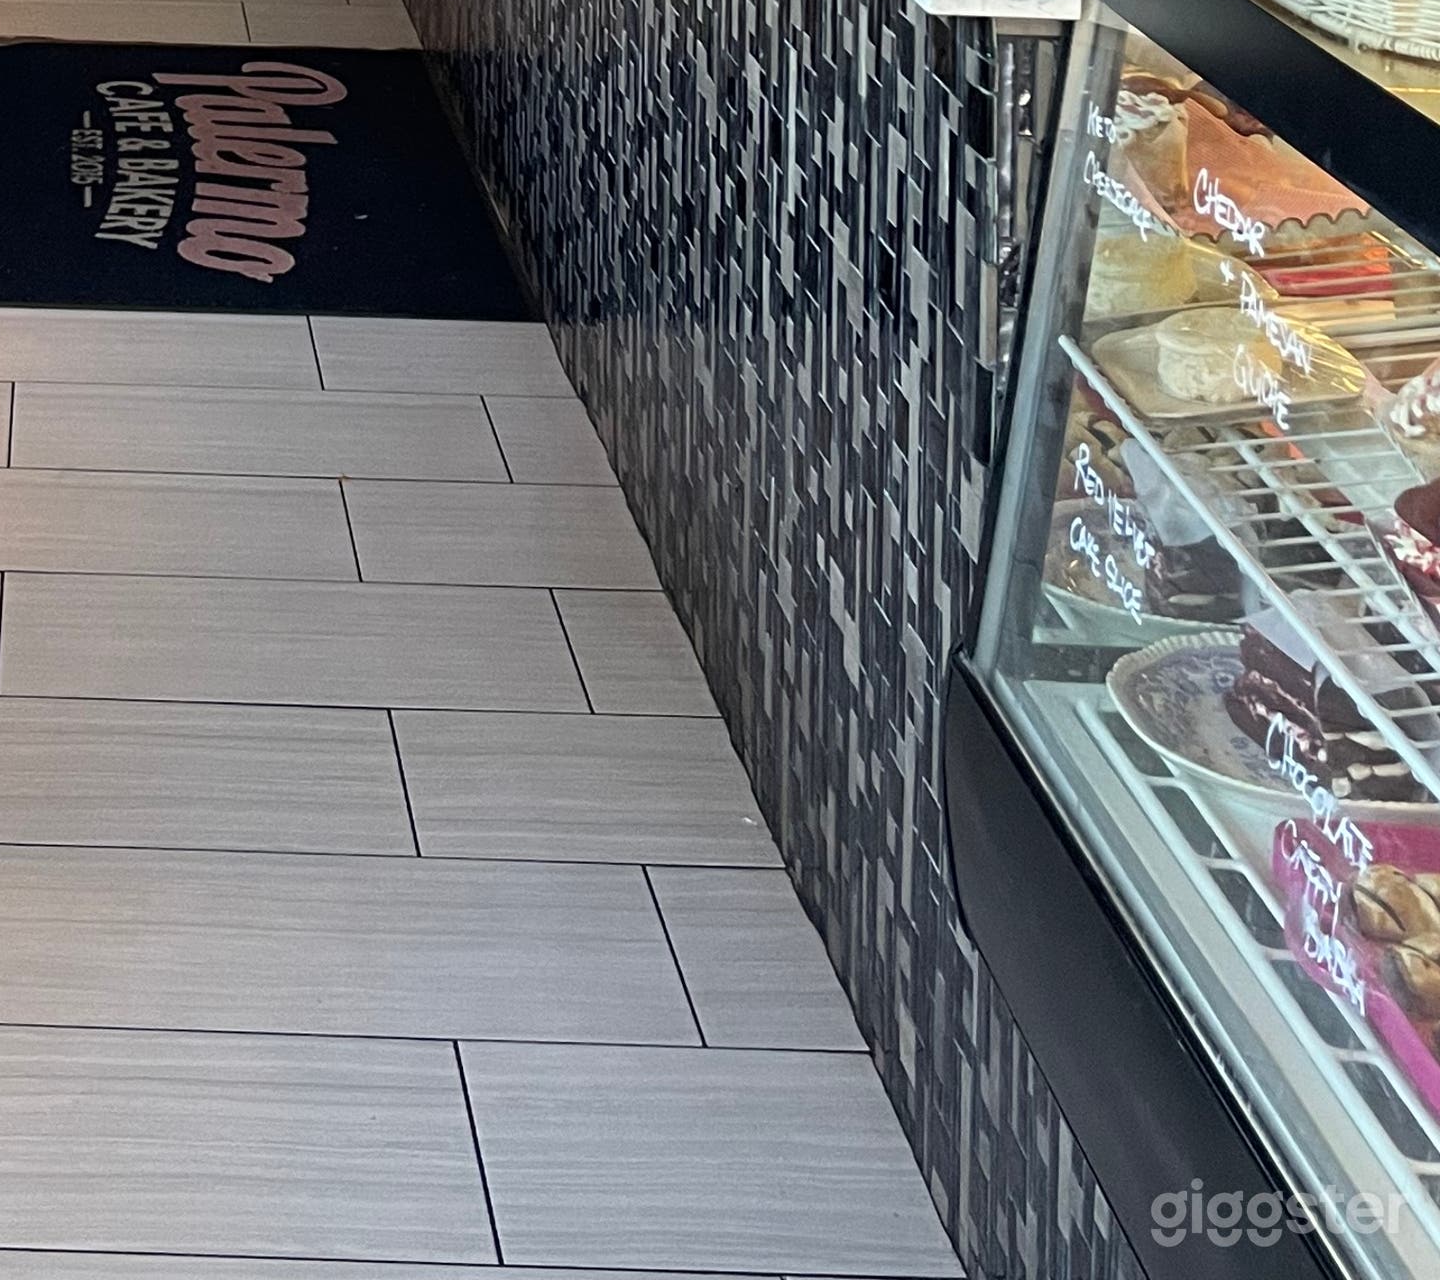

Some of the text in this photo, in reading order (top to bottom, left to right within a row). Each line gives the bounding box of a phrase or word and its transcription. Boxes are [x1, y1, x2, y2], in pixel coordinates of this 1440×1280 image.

[94, 80, 180, 250] CAFE & BAKERY
[151, 60, 349, 284] Palermo
[1193, 167, 1266, 259] CHEDDAR
[1074, 442, 1105, 506] RED
[1265, 711, 1374, 877] CHOCOLATE
